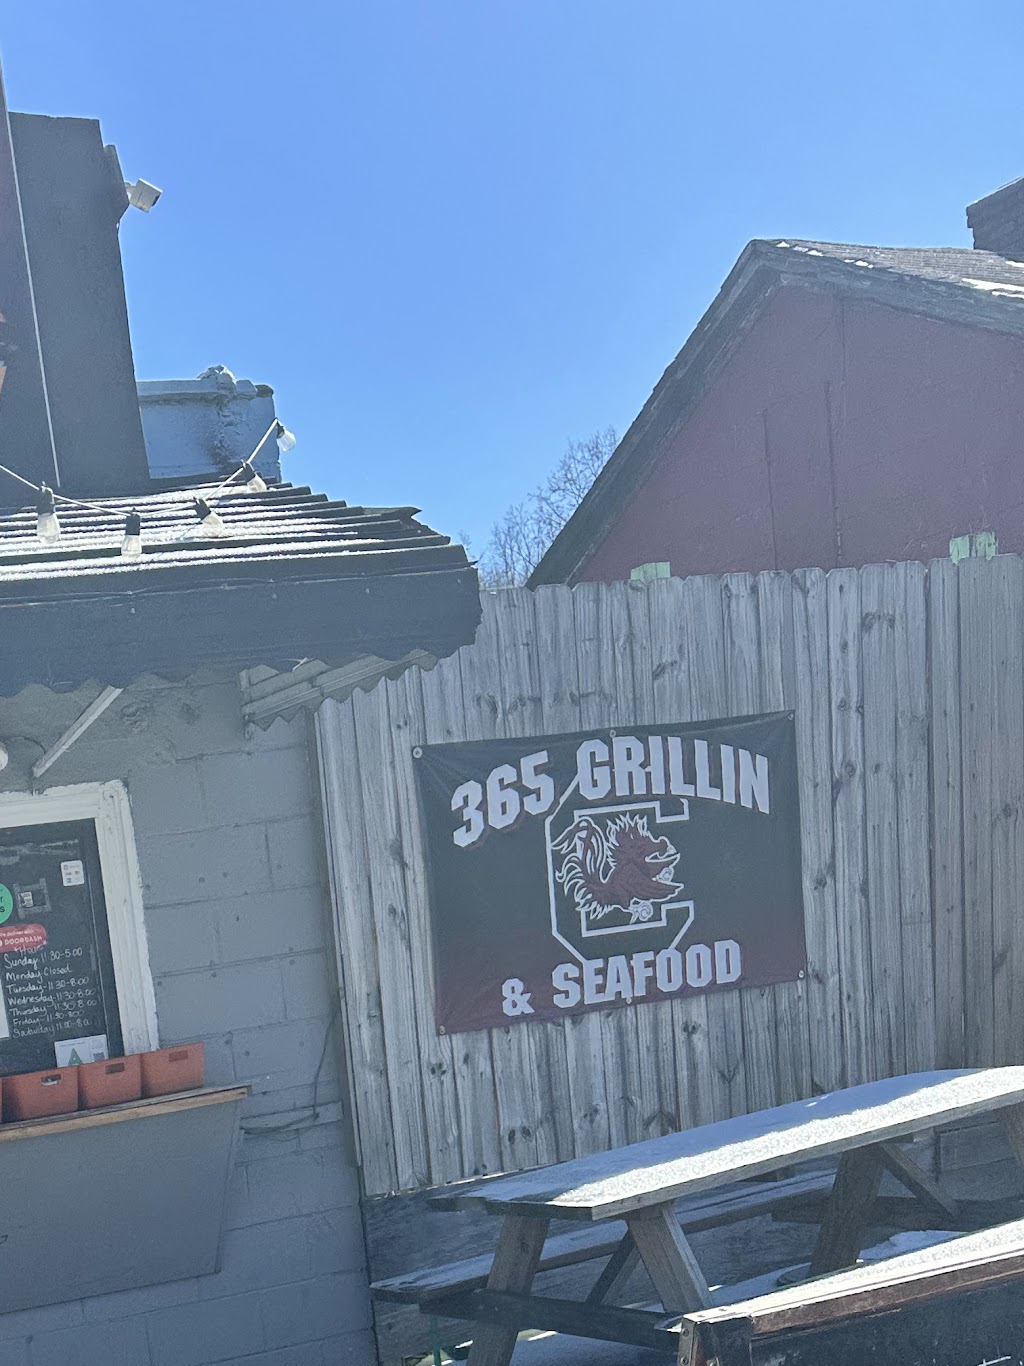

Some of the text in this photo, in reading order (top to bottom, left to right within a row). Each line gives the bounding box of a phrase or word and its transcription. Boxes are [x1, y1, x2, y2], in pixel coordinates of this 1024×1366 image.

[450, 735, 771, 848] 365 GRILLIN
[4, 935, 43, 946] DOORDASH
[501, 939, 742, 1017] & SEAFOOD
